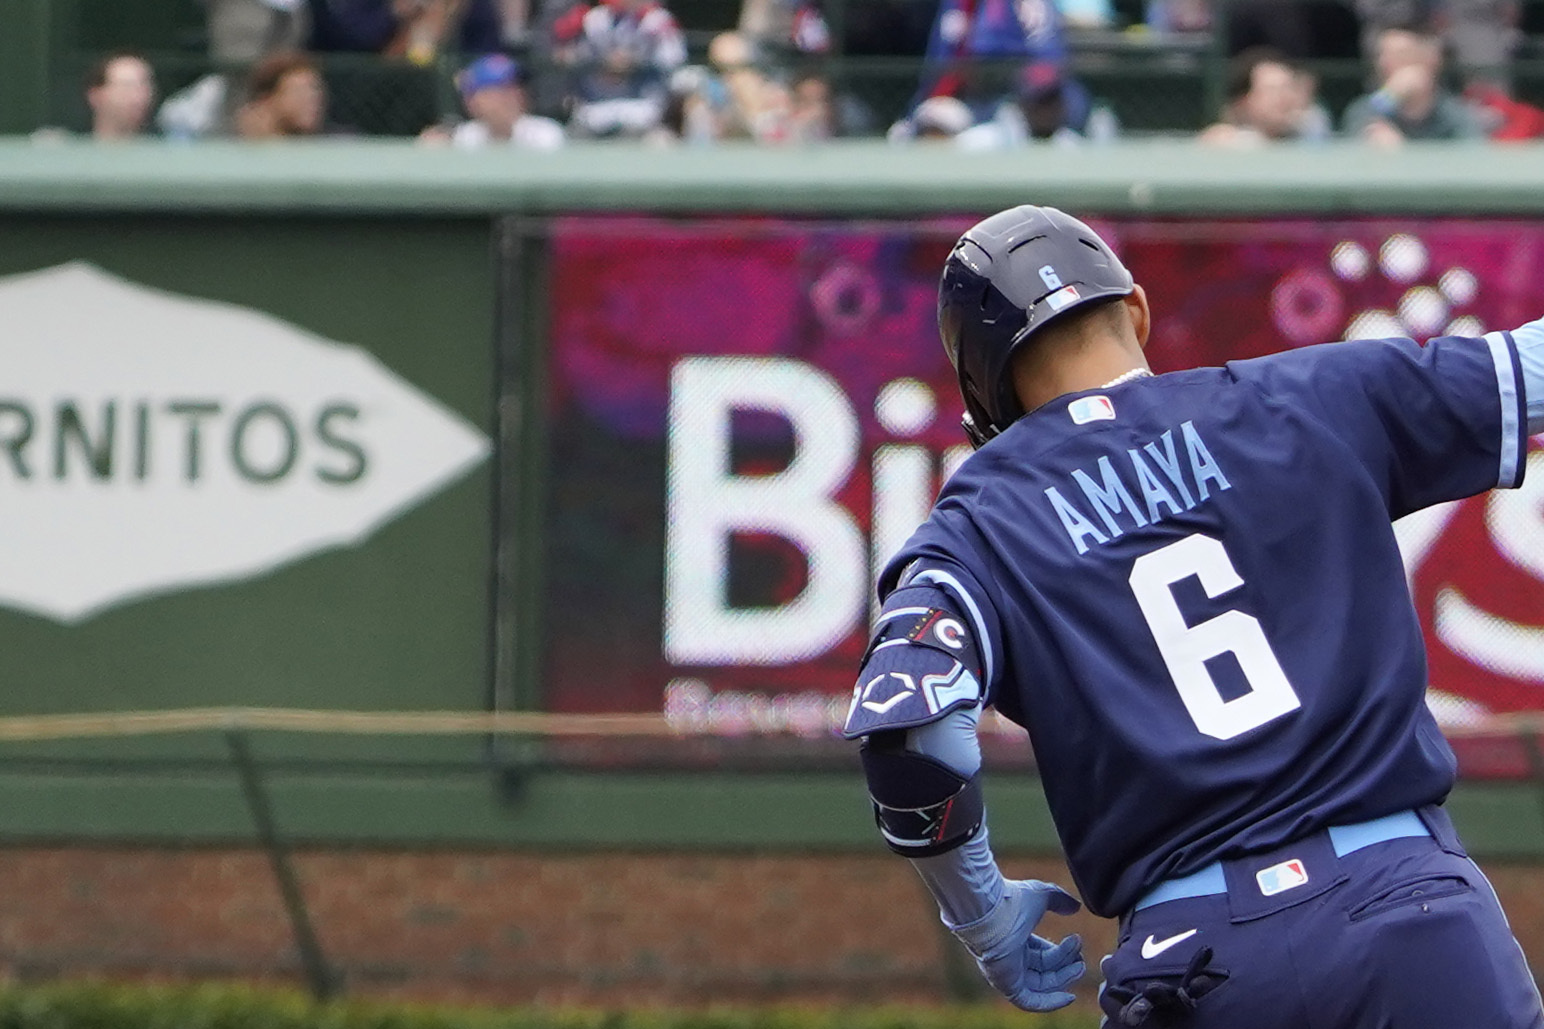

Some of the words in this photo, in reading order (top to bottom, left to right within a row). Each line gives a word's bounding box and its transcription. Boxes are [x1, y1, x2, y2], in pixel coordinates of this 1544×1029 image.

[1039, 265, 1062, 291] 6
[1044, 420, 1232, 555] AMAYA
[1128, 533, 1301, 741] 6
